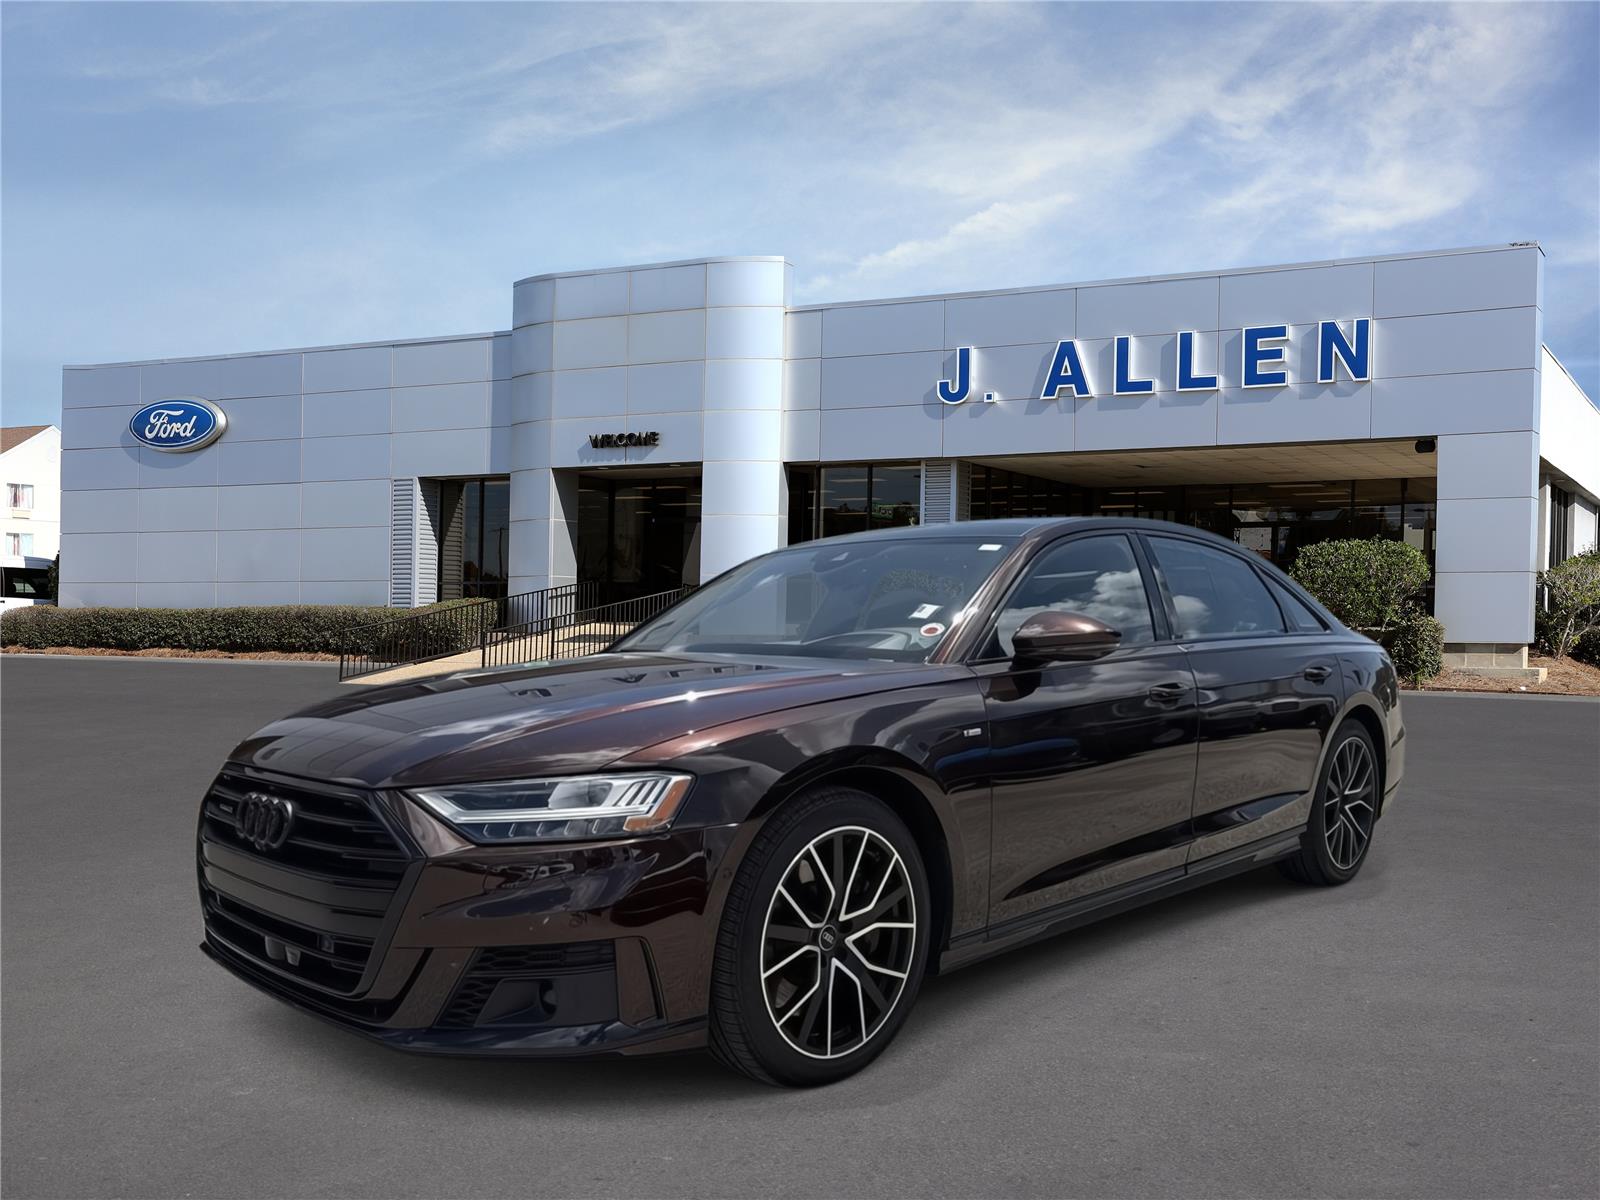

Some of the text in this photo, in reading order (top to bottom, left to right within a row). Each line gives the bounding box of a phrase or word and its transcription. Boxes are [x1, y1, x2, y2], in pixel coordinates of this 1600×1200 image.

[936, 316, 1373, 405] J. ALLEN
[144, 409, 198, 440] Ford
[589, 431, 660, 449] WELCOME
